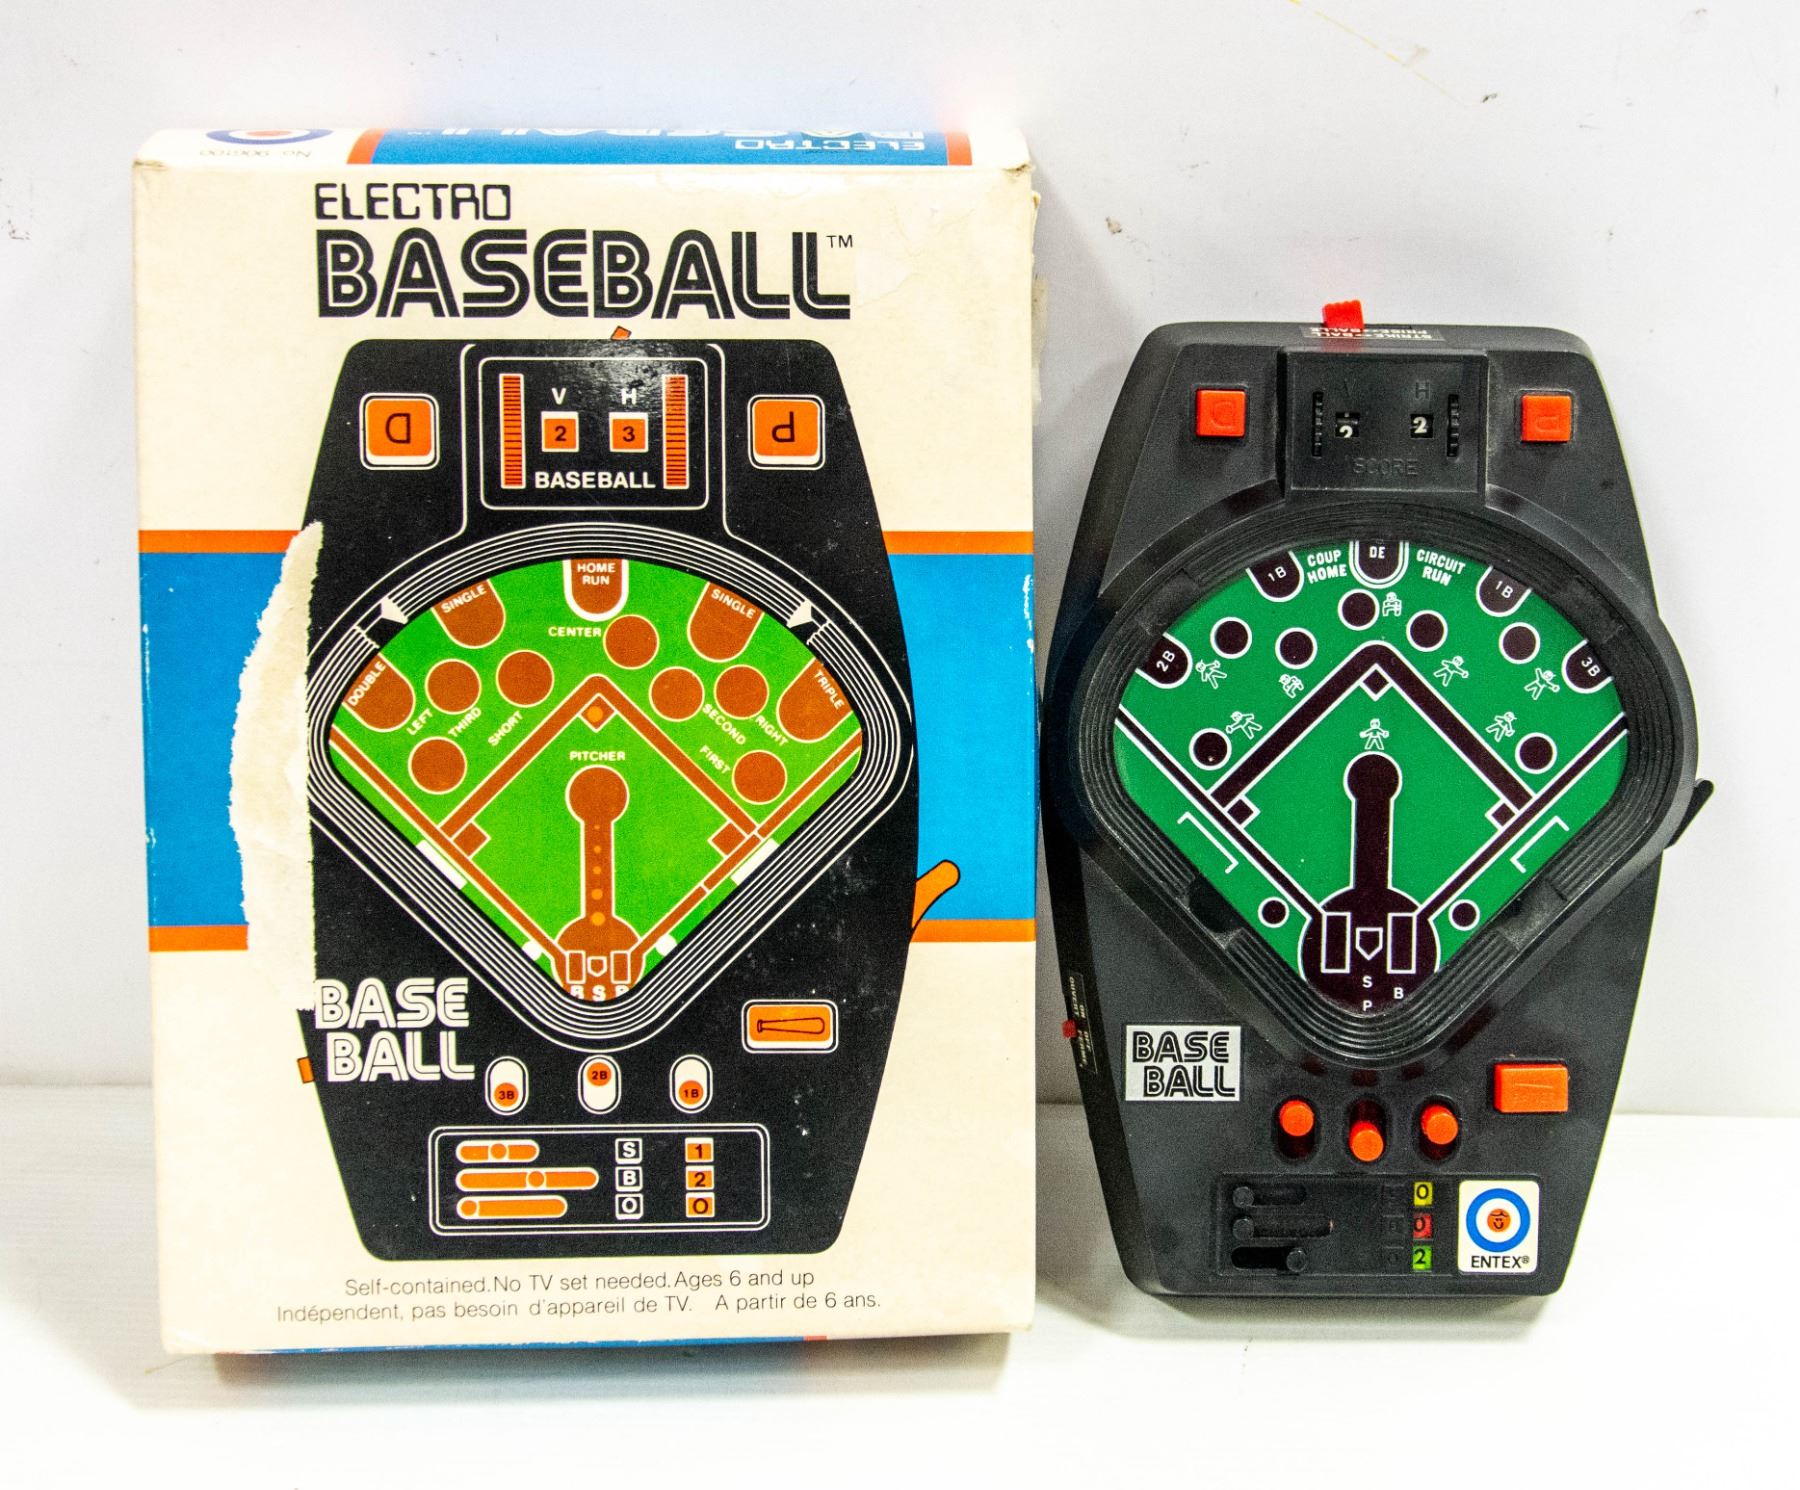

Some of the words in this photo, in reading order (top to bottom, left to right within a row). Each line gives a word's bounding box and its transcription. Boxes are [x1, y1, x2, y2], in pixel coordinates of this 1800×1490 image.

[735, 139, 925, 151] ELECTRO
[315, 183, 511, 220] ELECTRO
[316, 227, 851, 320] BASEBALL
[551, 387, 567, 405] V
[620, 387, 637, 405] H
[385, 412, 411, 444] D
[554, 425, 567, 442] 2
[622, 425, 636, 442] 3
[1413, 416, 1428, 434] 2
[1352, 457, 1420, 476] SCORE
[534, 471, 656, 489] BASEBALL
[1306, 550, 1342, 568] COUP
[1369, 546, 1386, 559] DE
[1415, 548, 1466, 576] CIRCUIT
[576, 562, 616, 573] HOME
[1306, 564, 1348, 585] HOME
[1421, 565, 1453, 588] RUN
[582, 574, 610, 586] RUN
[440, 584, 488, 614] SINGLE
[709, 587, 757, 620] SINGLE
[547, 626, 602, 638] CENTER
[1155, 649, 1177, 672] 2B
[1580, 655, 1601, 677] 3B
[347, 660, 387, 707] DOUBLE
[813, 669, 845, 711] TRIPLE
[406, 708, 434, 736] LEFT
[448, 706, 483, 738] THIRD
[487, 710, 525, 748] SHORT
[702, 703, 747, 746] SECOND
[754, 714, 790, 747] RIGHT
[569, 750, 626, 761] PITCHER
[699, 745, 732, 775] FIRST
[1362, 975, 1373, 988] S
[592, 984, 607, 1002] S
[1393, 986, 1405, 999] B
[314, 977, 470, 1030] BASE
[1363, 1000, 1373, 1012] P
[326, 1031, 475, 1083] BALL
[1132, 1031, 1230, 1063] BASE
[592, 1070, 608, 1081] 2B
[1143, 1065, 1236, 1098] BALL
[498, 1091, 515, 1101] 3B
[684, 1088, 700, 1099] 1B
[622, 1142, 637, 1158] S
[695, 1143, 703, 1160] 1
[622, 1171, 637, 1187] B
[694, 1172, 706, 1188] 2
[1413, 1248, 1426, 1264] 2
[345, 1278, 491, 1296] Self-contained.
[494, 1275, 521, 1292] No
[528, 1274, 553, 1291] TV
[559, 1274, 588, 1291] set
[595, 1272, 670, 1289] needed.
[674, 1270, 723, 1291] Ages
[729, 1269, 742, 1286] 6
[748, 1269, 783, 1286] and
[791, 1271, 815, 1288] up
[411, 1303, 446, 1321] pas
[454, 1301, 518, 1319] besoin
[528, 1296, 625, 1318] d'appareil
[633, 1296, 658, 1313] de
[664, 1295, 692, 1312] TV.
[714, 1294, 729, 1310] A
[736, 1293, 787, 1313] partir
[793, 1292, 817, 1309] de
[824, 1292, 837, 1308] 6
[843, 1292, 881, 1308] ans.
